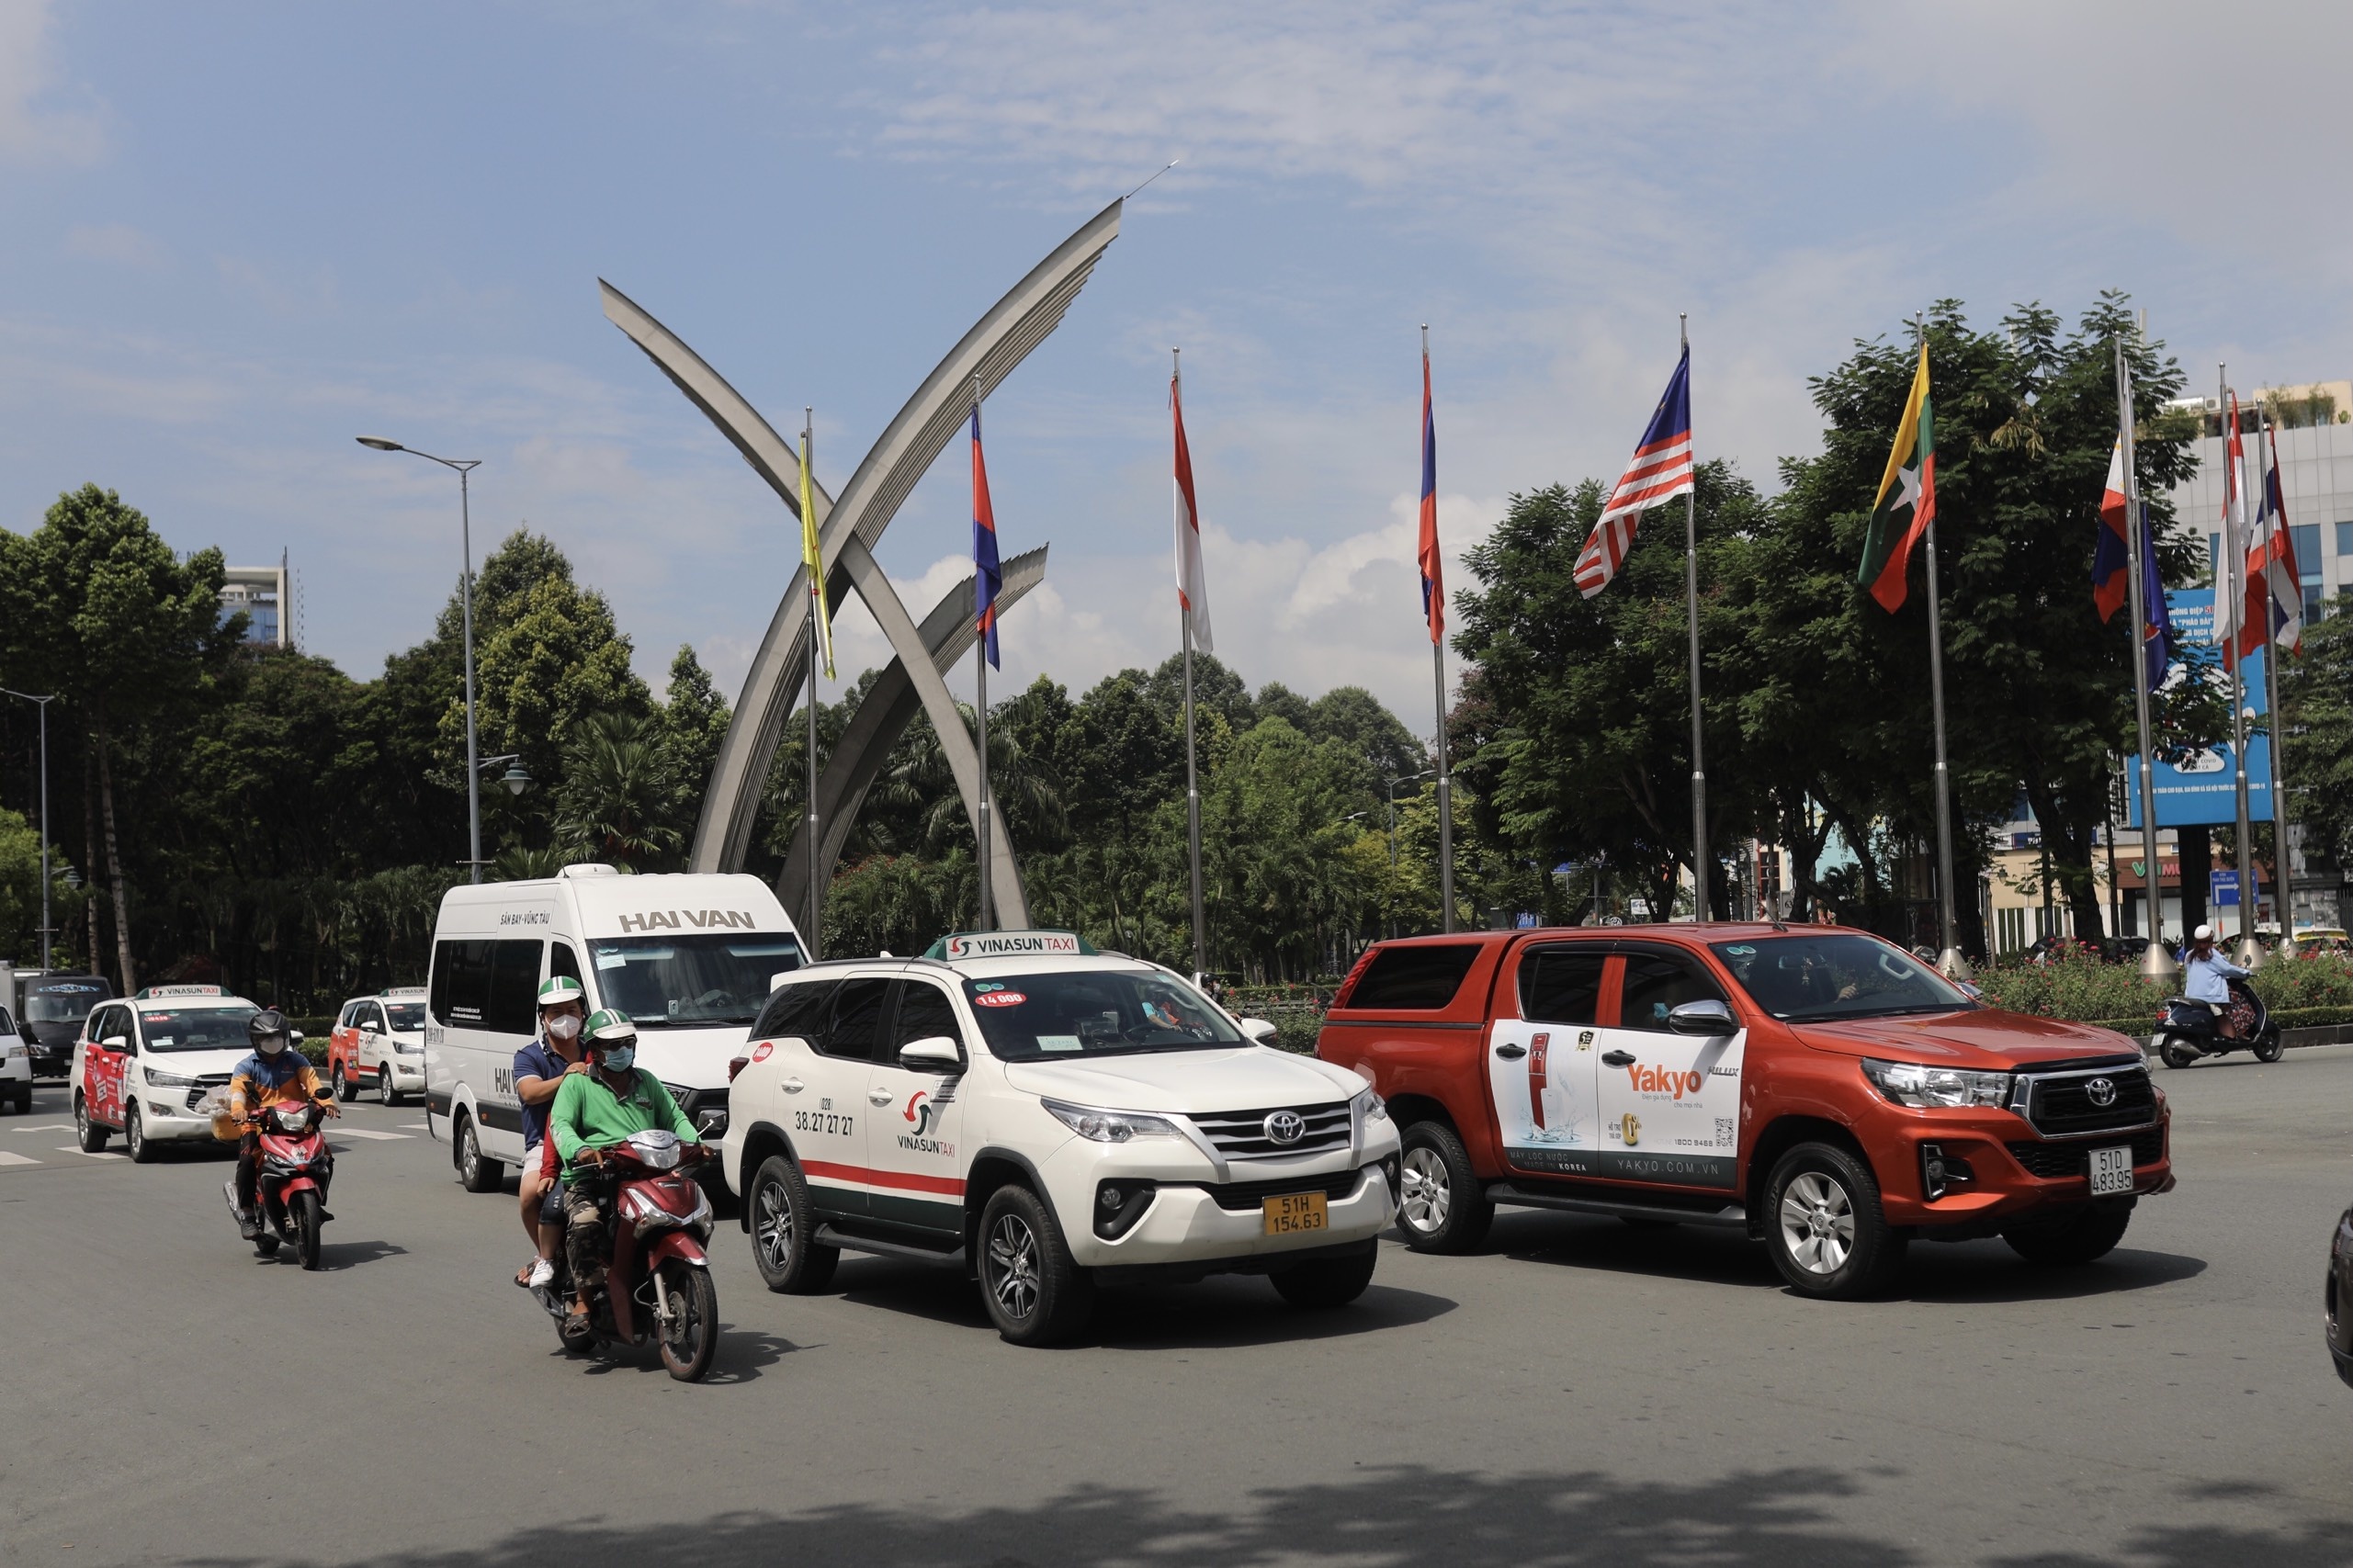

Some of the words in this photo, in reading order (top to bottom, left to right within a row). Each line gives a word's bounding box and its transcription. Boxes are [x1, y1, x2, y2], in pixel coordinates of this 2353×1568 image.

[618, 910, 682, 933] HAI
[682, 910, 756, 930] VAN
[977, 937, 1043, 953] VINASUN
[1044, 938, 1075, 951] TAXI
[495, 1067, 511, 1094] HAI
[1627, 1064, 1702, 1100] Yakyo
[819, 1098, 833, 1111] (028)
[796, 1111, 823, 1133] 38.27
[827, 1114, 839, 1134] 27
[842, 1116, 854, 1136] 27
[897, 1134, 939, 1155] VINASUN
[939, 1141, 956, 1157] TAXI
[1558, 1163, 1587, 1172] KOREA
[1617, 1159, 1718, 1175] YAKYO.COM.VN
[2099, 1150, 2122, 1171] 51D
[2093, 1169, 2132, 1192] 483.95
[1282, 1195, 1309, 1213] 51H
[1273, 1213, 1320, 1232] 154.63
